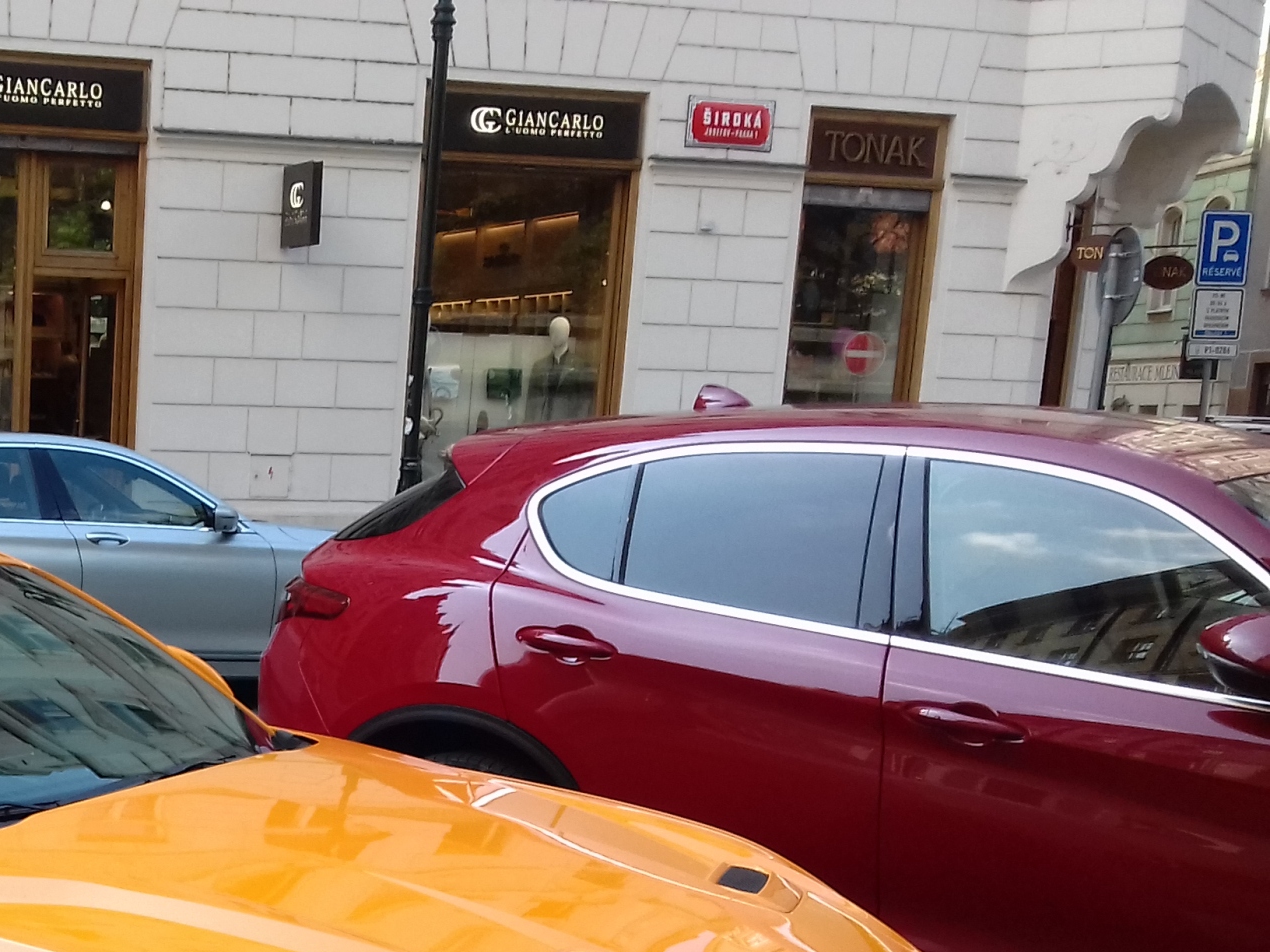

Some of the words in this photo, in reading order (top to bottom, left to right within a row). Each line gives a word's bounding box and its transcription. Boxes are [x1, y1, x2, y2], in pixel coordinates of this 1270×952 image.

[43, 97, 103, 109] PERFETTO
[702, 106, 762, 129] ŠIROKÁ
[505, 125, 546, 136] L'UOMO
[550, 129, 603, 140] PERFETTO
[824, 129, 928, 168] TONAK
[1076, 246, 1104, 260] TON
[1161, 266, 1187, 278] NAK
[1201, 264, 1243, 278] RÉSERVÉ
[1155, 364, 1179, 380] MLEJN
